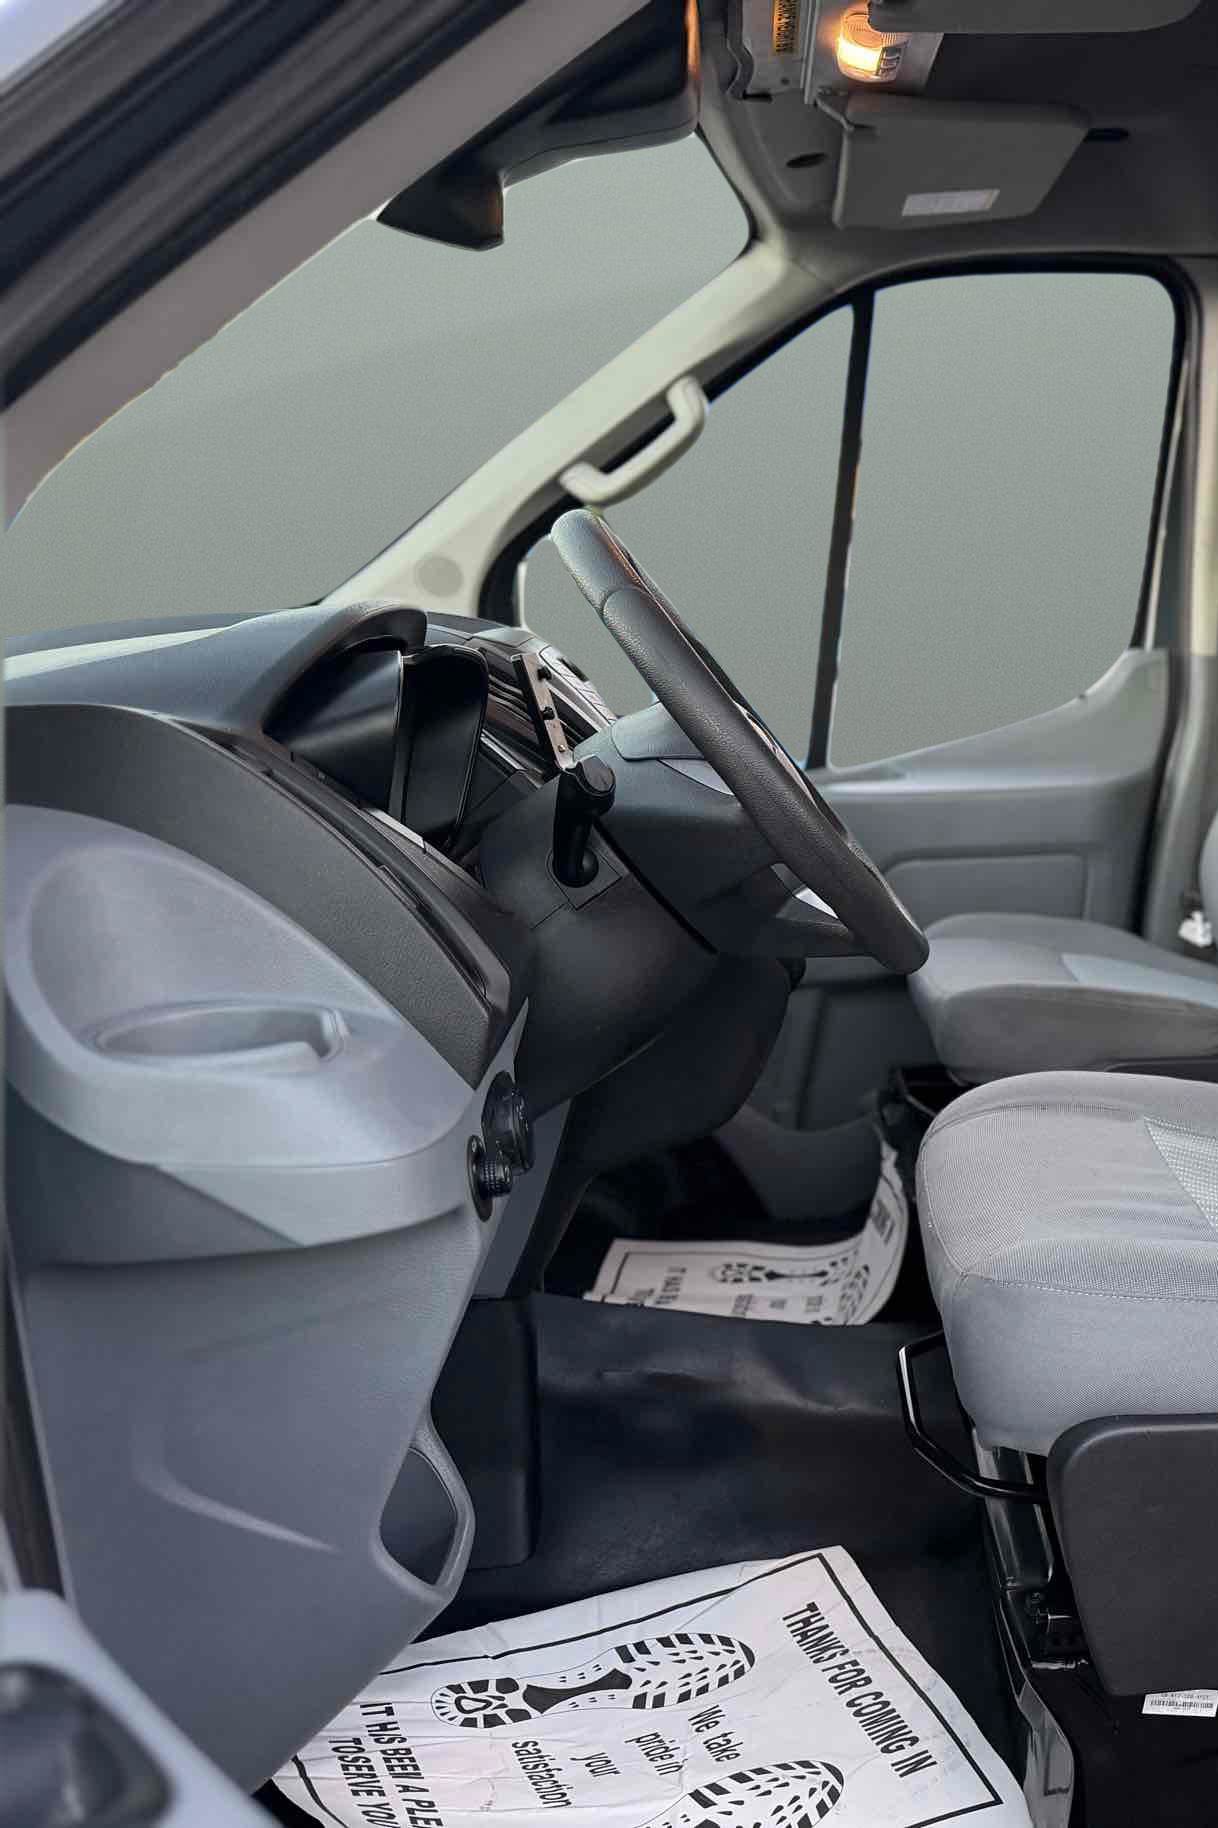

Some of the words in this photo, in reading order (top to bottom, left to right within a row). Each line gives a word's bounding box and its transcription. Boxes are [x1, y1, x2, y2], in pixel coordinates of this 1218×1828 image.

[782, 1601, 850, 1664] THANKS
[821, 1659, 873, 1696] FOR
[360, 1702, 394, 1716] IT
[688, 1704, 726, 1733] We
[845, 1691, 920, 1754] COMING
[328, 1738, 366, 1754] TO
[624, 1731, 680, 1762] pride
[654, 1758, 688, 1776] in
[703, 1731, 744, 1763] take
[337, 1756, 386, 1797] SERVE
[511, 1740, 572, 1809] satisfaction
[570, 1751, 621, 1778] your
[890, 1750, 937, 1778] IN
[395, 1784, 429, 1793] A
[402, 1798, 443, 1828] PLE
